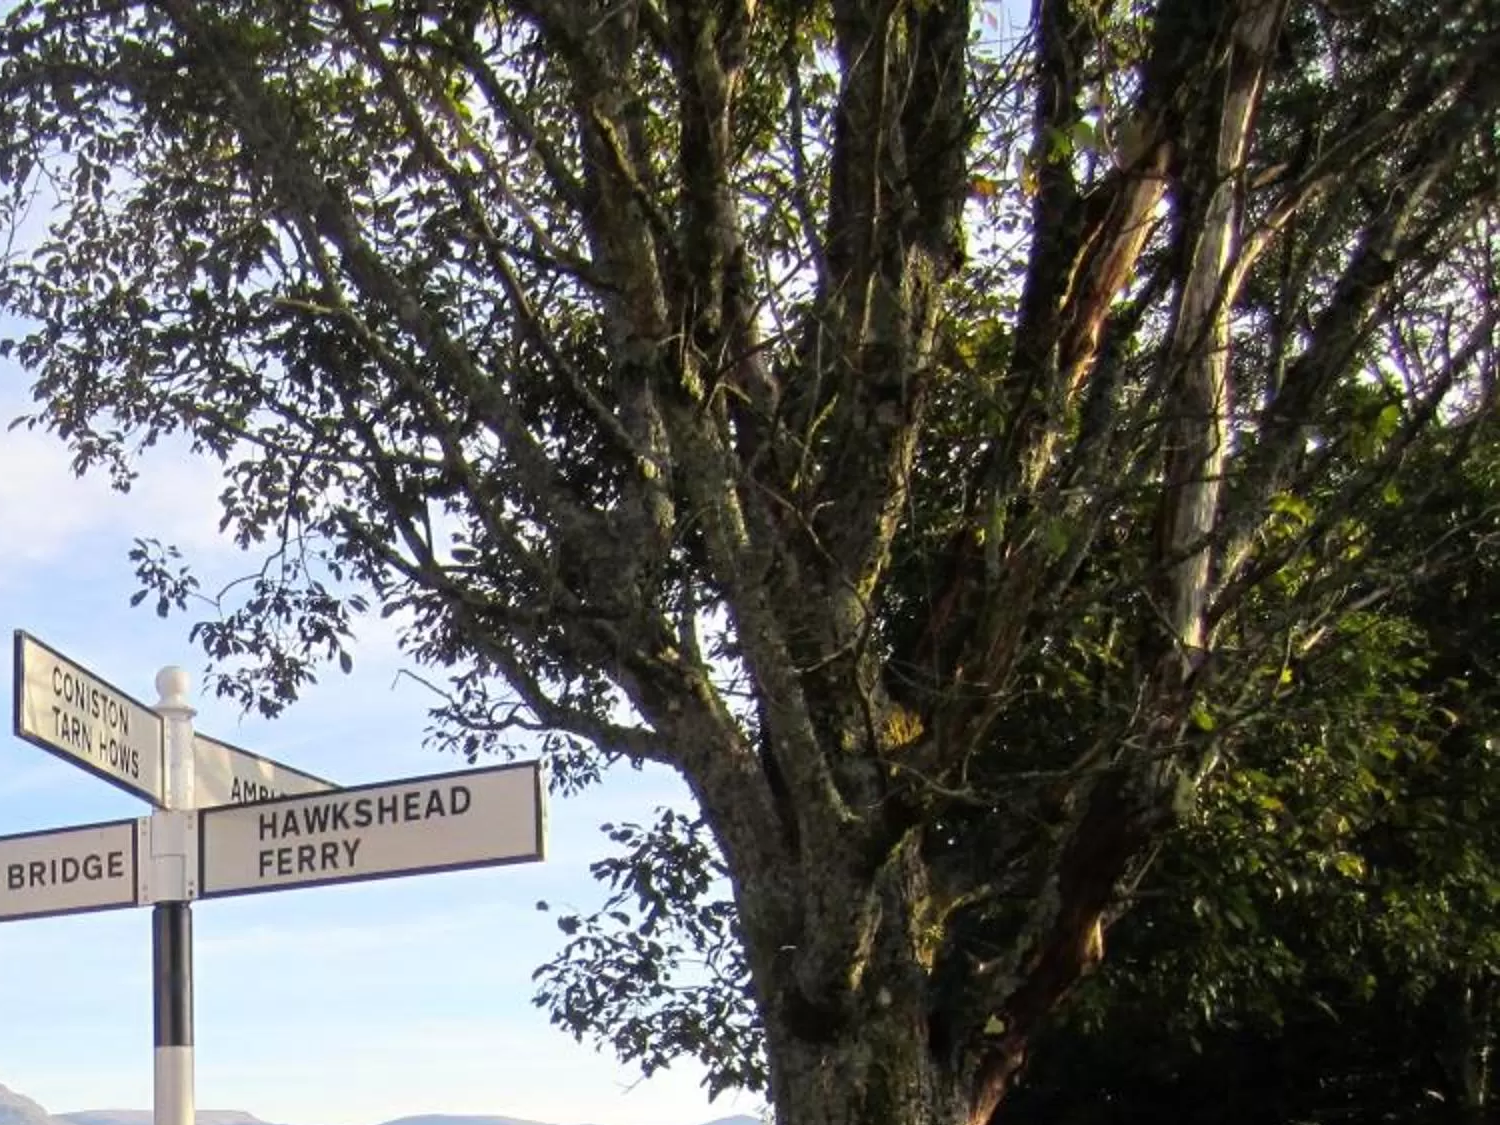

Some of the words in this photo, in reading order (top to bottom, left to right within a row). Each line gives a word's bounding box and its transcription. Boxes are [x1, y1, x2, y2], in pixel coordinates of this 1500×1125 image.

[52, 666, 129, 736] CONISTON
[52, 706, 92, 754] TARN
[100, 730, 139, 779] HOWS
[258, 785, 471, 841] HAWKSHEAD
[7, 851, 124, 890] BRIDGE
[258, 838, 361, 878] FERRY
